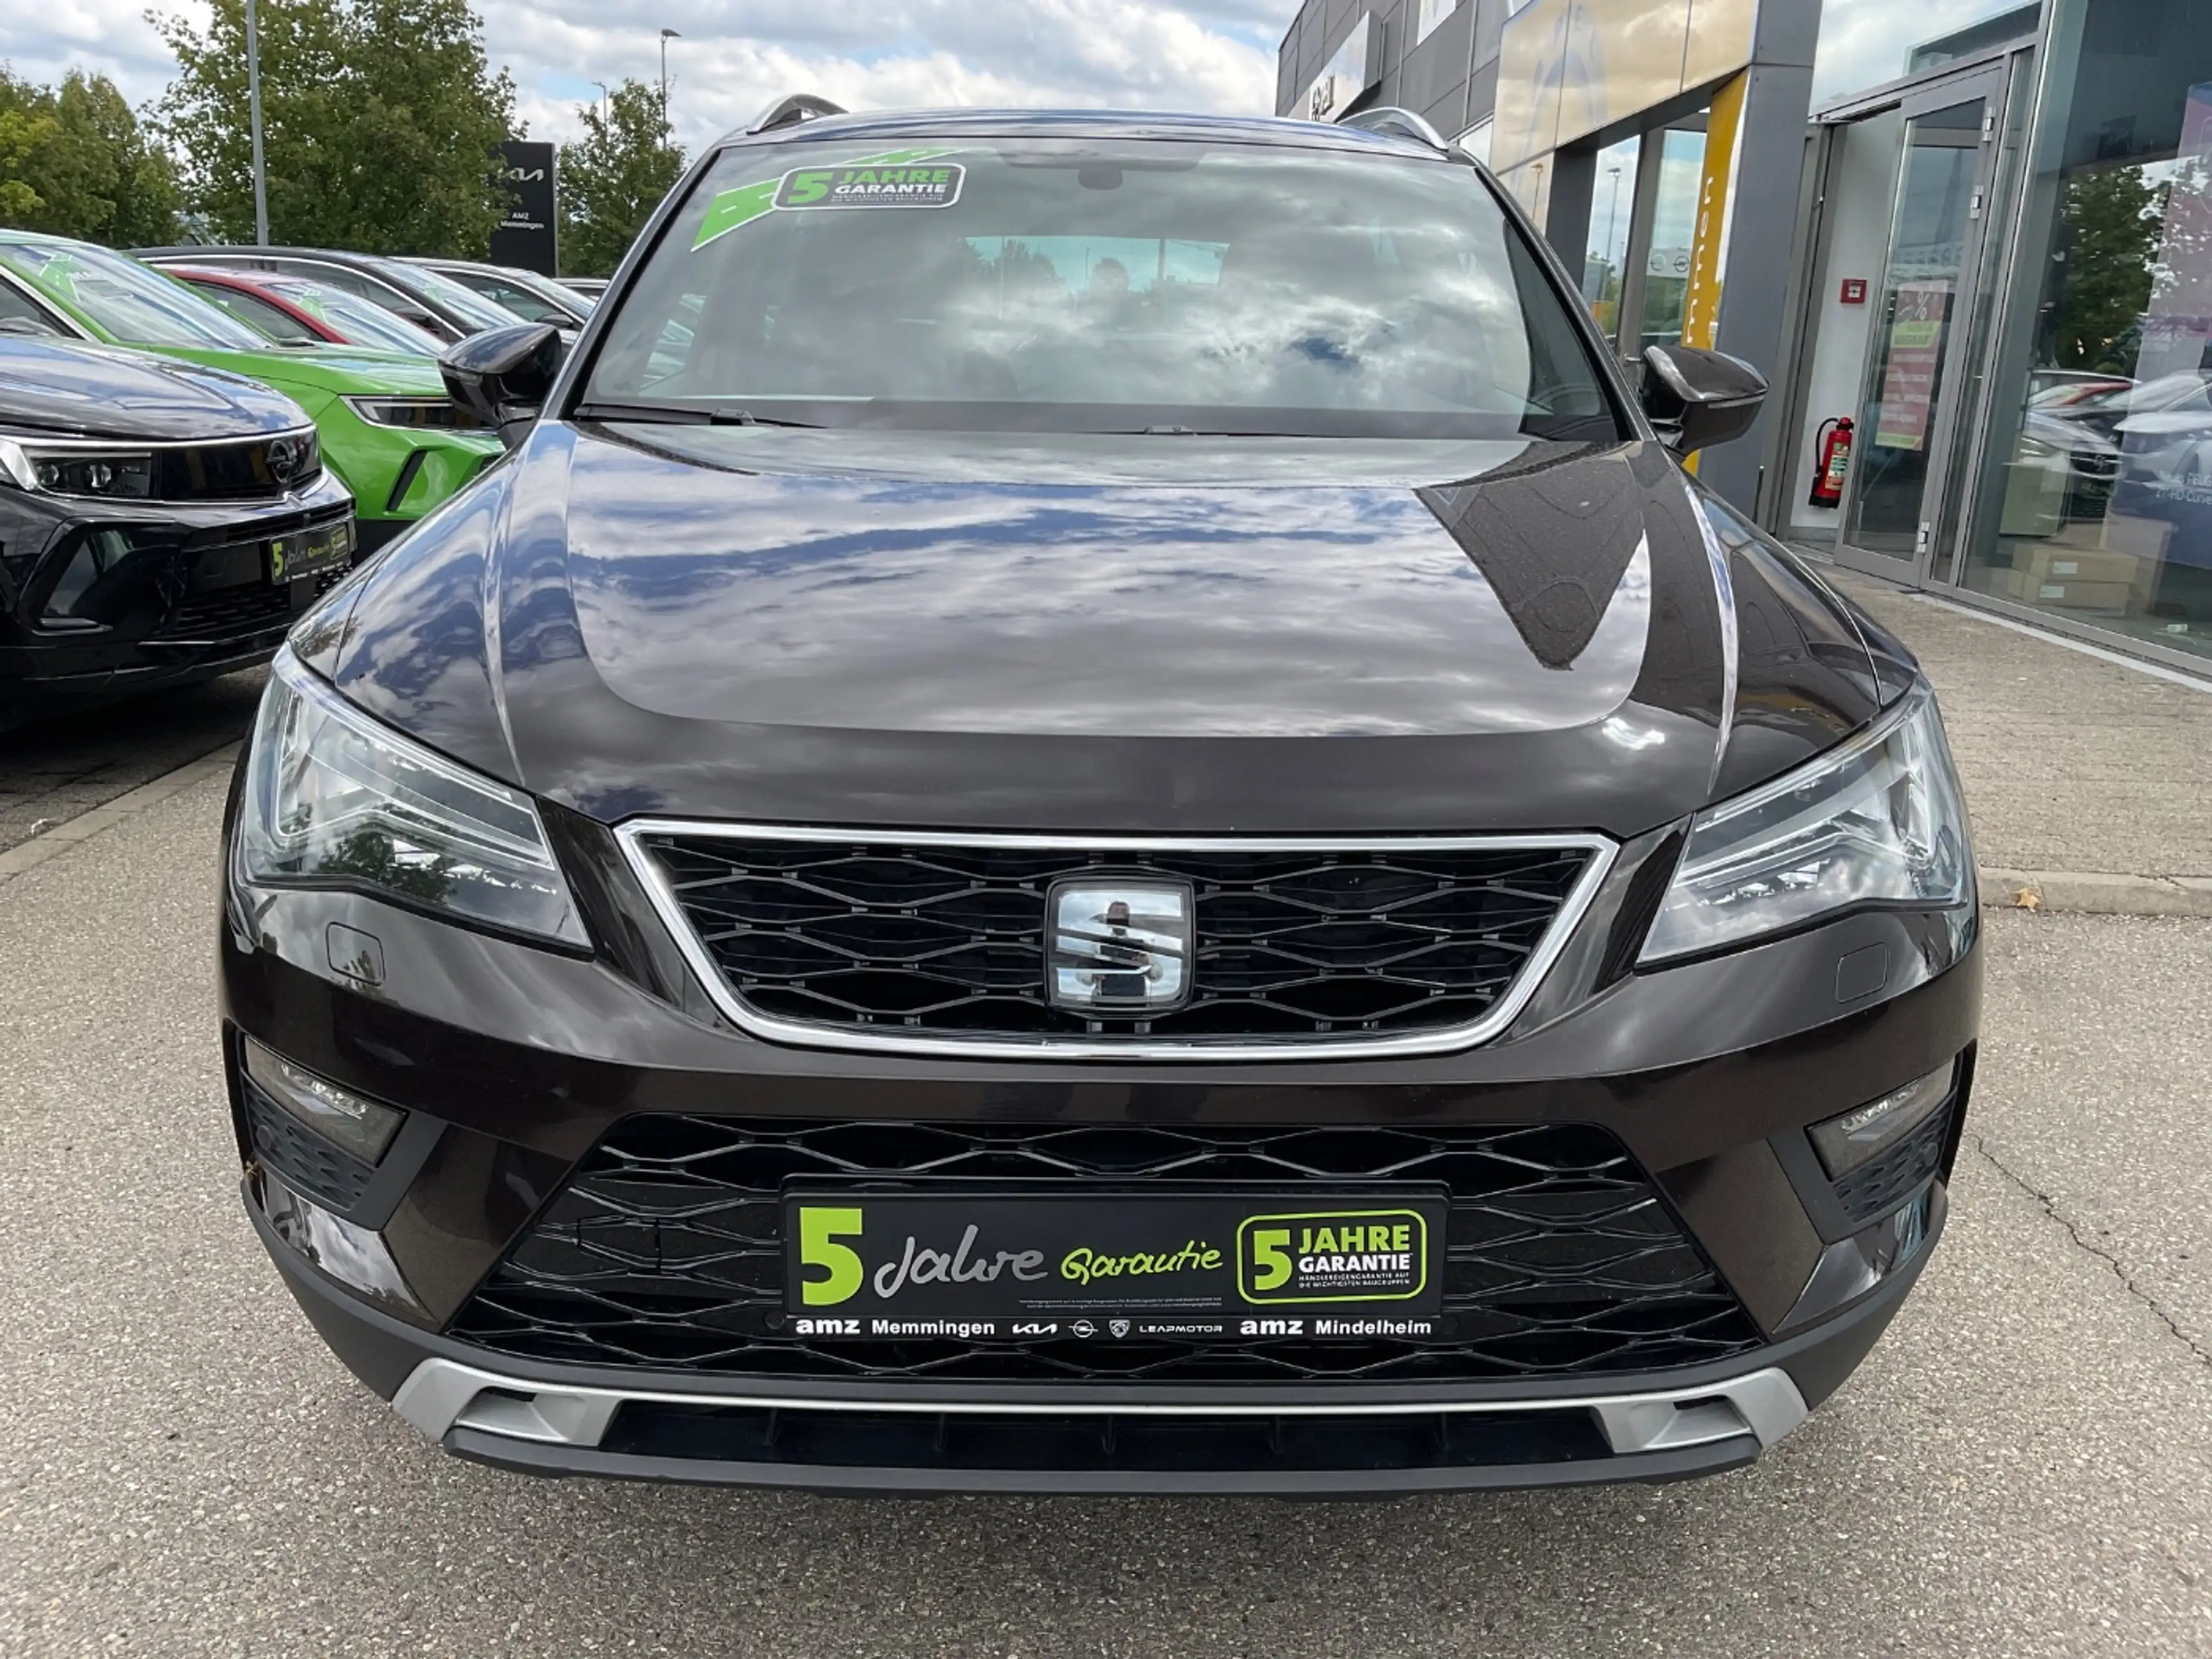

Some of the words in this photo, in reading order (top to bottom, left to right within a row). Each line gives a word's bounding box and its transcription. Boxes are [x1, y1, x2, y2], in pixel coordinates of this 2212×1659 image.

[787, 172, 834, 204] 5
[835, 184, 947, 194] GARANTIE
[839, 170, 950, 184] JAHRE
[272, 541, 283, 577] 5
[1299, 1225, 1410, 1253] JAHRE
[800, 1207, 863, 1305] 5
[874, 1225, 1048, 1298] Jahre
[1253, 1229, 1293, 1290] 5
[1299, 1254, 1411, 1272] GARANTIE
[796, 1319, 860, 1334] amz
[872, 1320, 995, 1338] Memmingen
[1139, 1325, 1223, 1333] LEAPMOTOR
[1240, 1320, 1304, 1335] amz
[1316, 1320, 1431, 1335] Mindelheim
